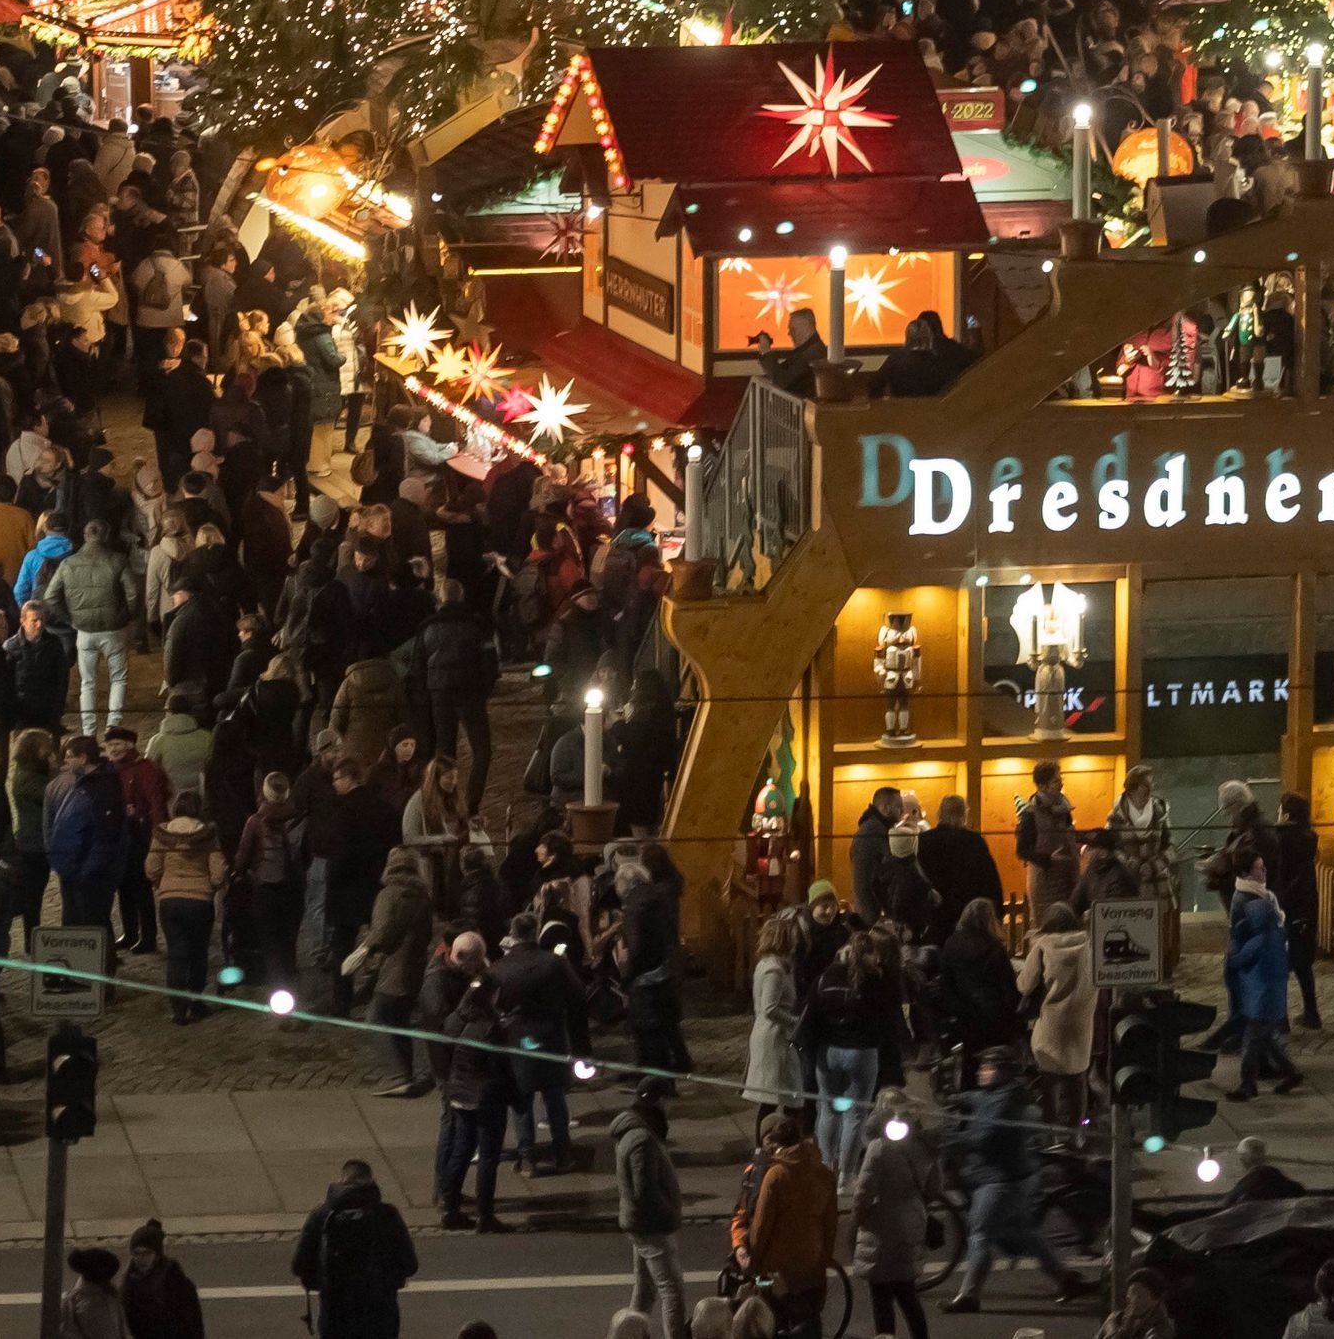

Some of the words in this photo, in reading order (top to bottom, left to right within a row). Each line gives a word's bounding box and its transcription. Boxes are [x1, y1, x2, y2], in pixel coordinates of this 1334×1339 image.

[952, 100, 995, 120] 2022
[606, 270, 667, 319] HERRNHUTER
[1100, 907, 1154, 920] Vorrang
[41, 933, 97, 950] Vorrang
